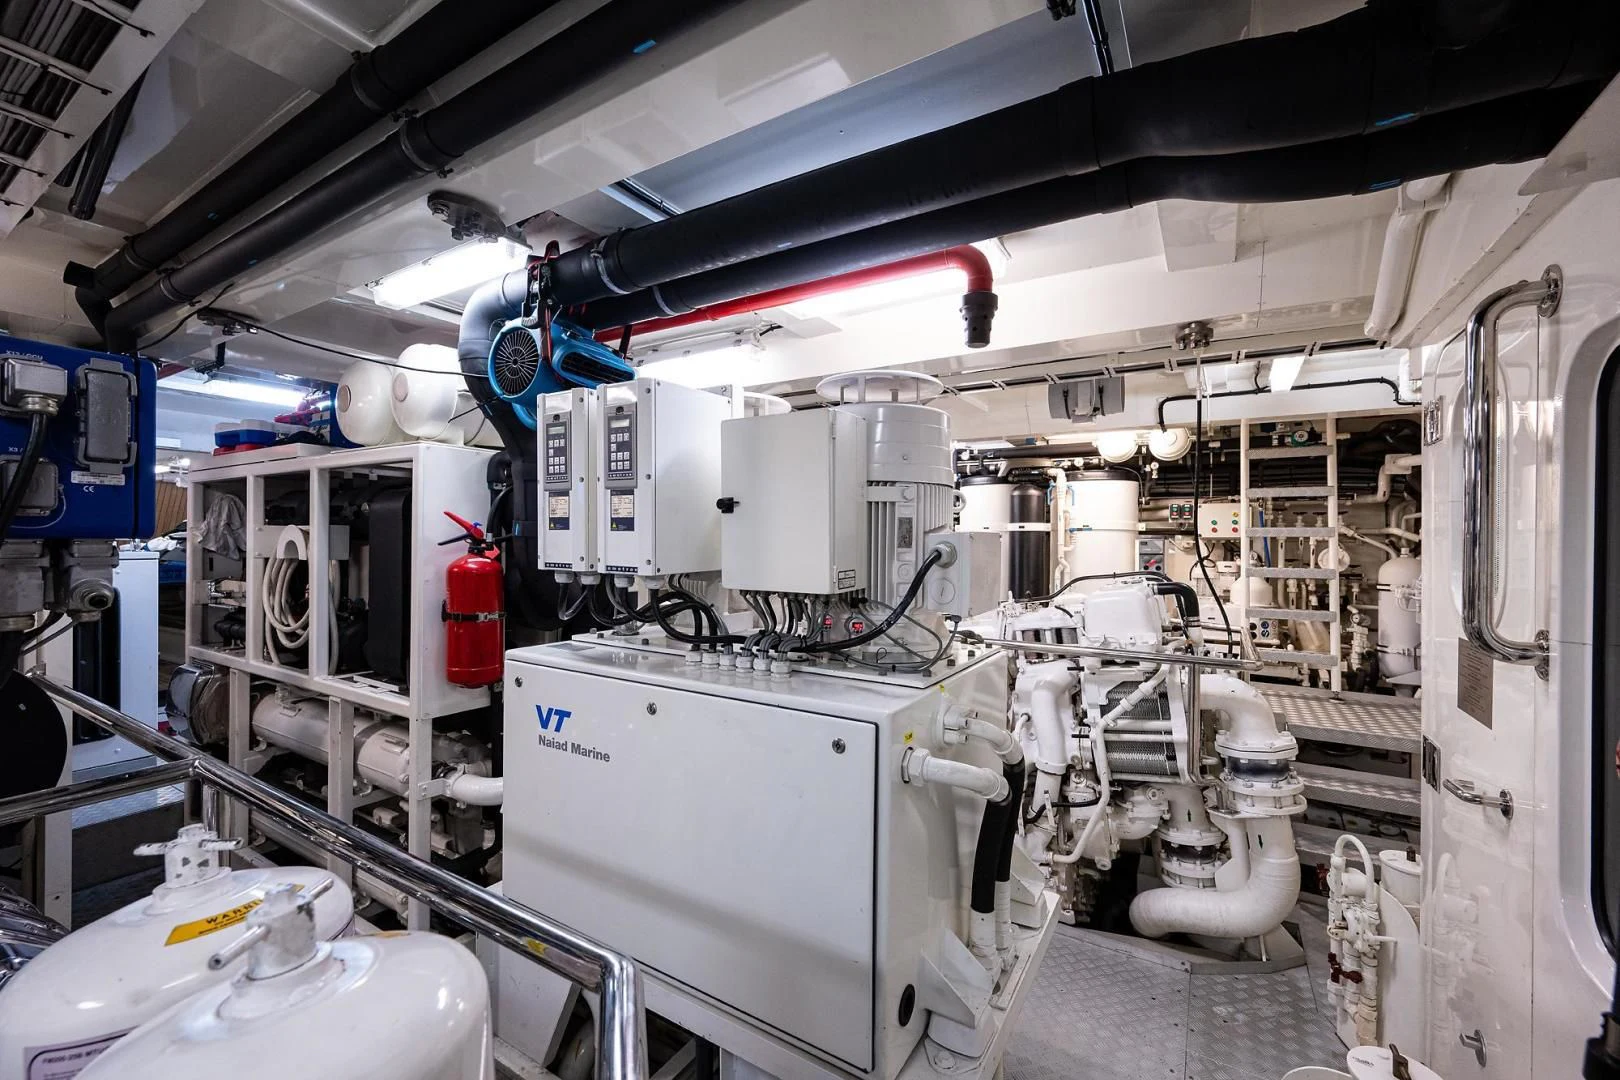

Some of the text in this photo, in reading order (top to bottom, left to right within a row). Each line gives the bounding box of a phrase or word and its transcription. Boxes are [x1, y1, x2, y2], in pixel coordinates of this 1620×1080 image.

[535, 704, 572, 733] VT
[538, 734, 611, 762] Naiad Marine
